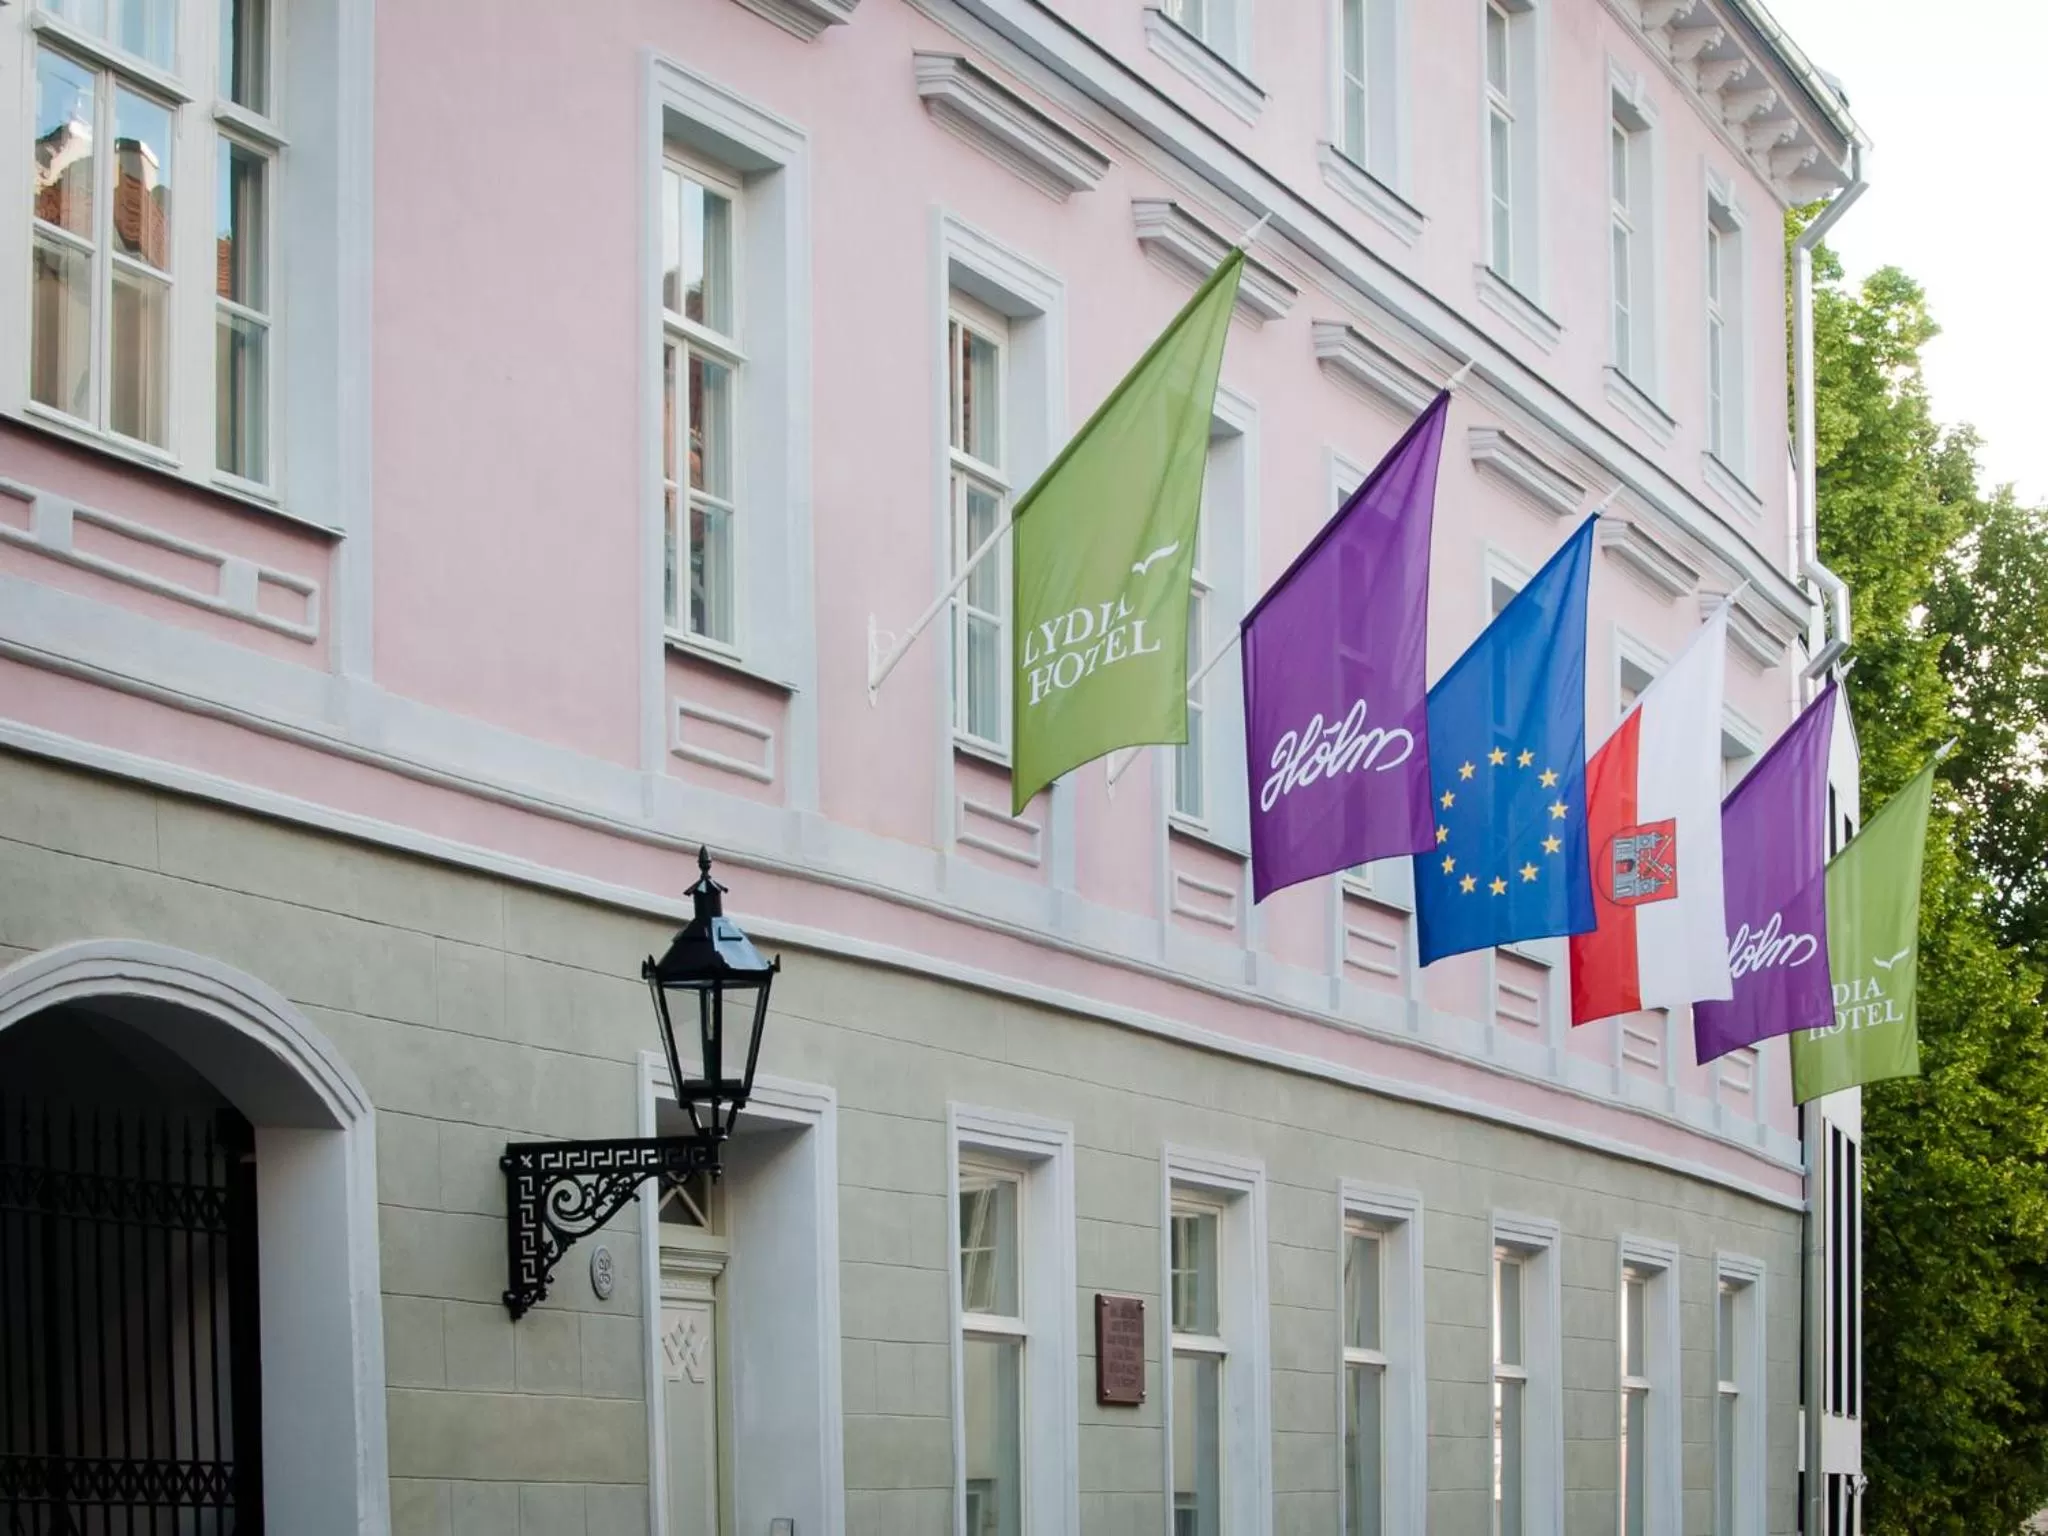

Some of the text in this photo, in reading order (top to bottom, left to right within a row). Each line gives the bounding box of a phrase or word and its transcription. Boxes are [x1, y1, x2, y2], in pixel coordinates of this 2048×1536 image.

[1022, 592, 1135, 669] LYDIA
[1028, 619, 1160, 706] HOTEL
[1261, 698, 1414, 812] Hõlm
[1831, 976, 1885, 1008] DIA
